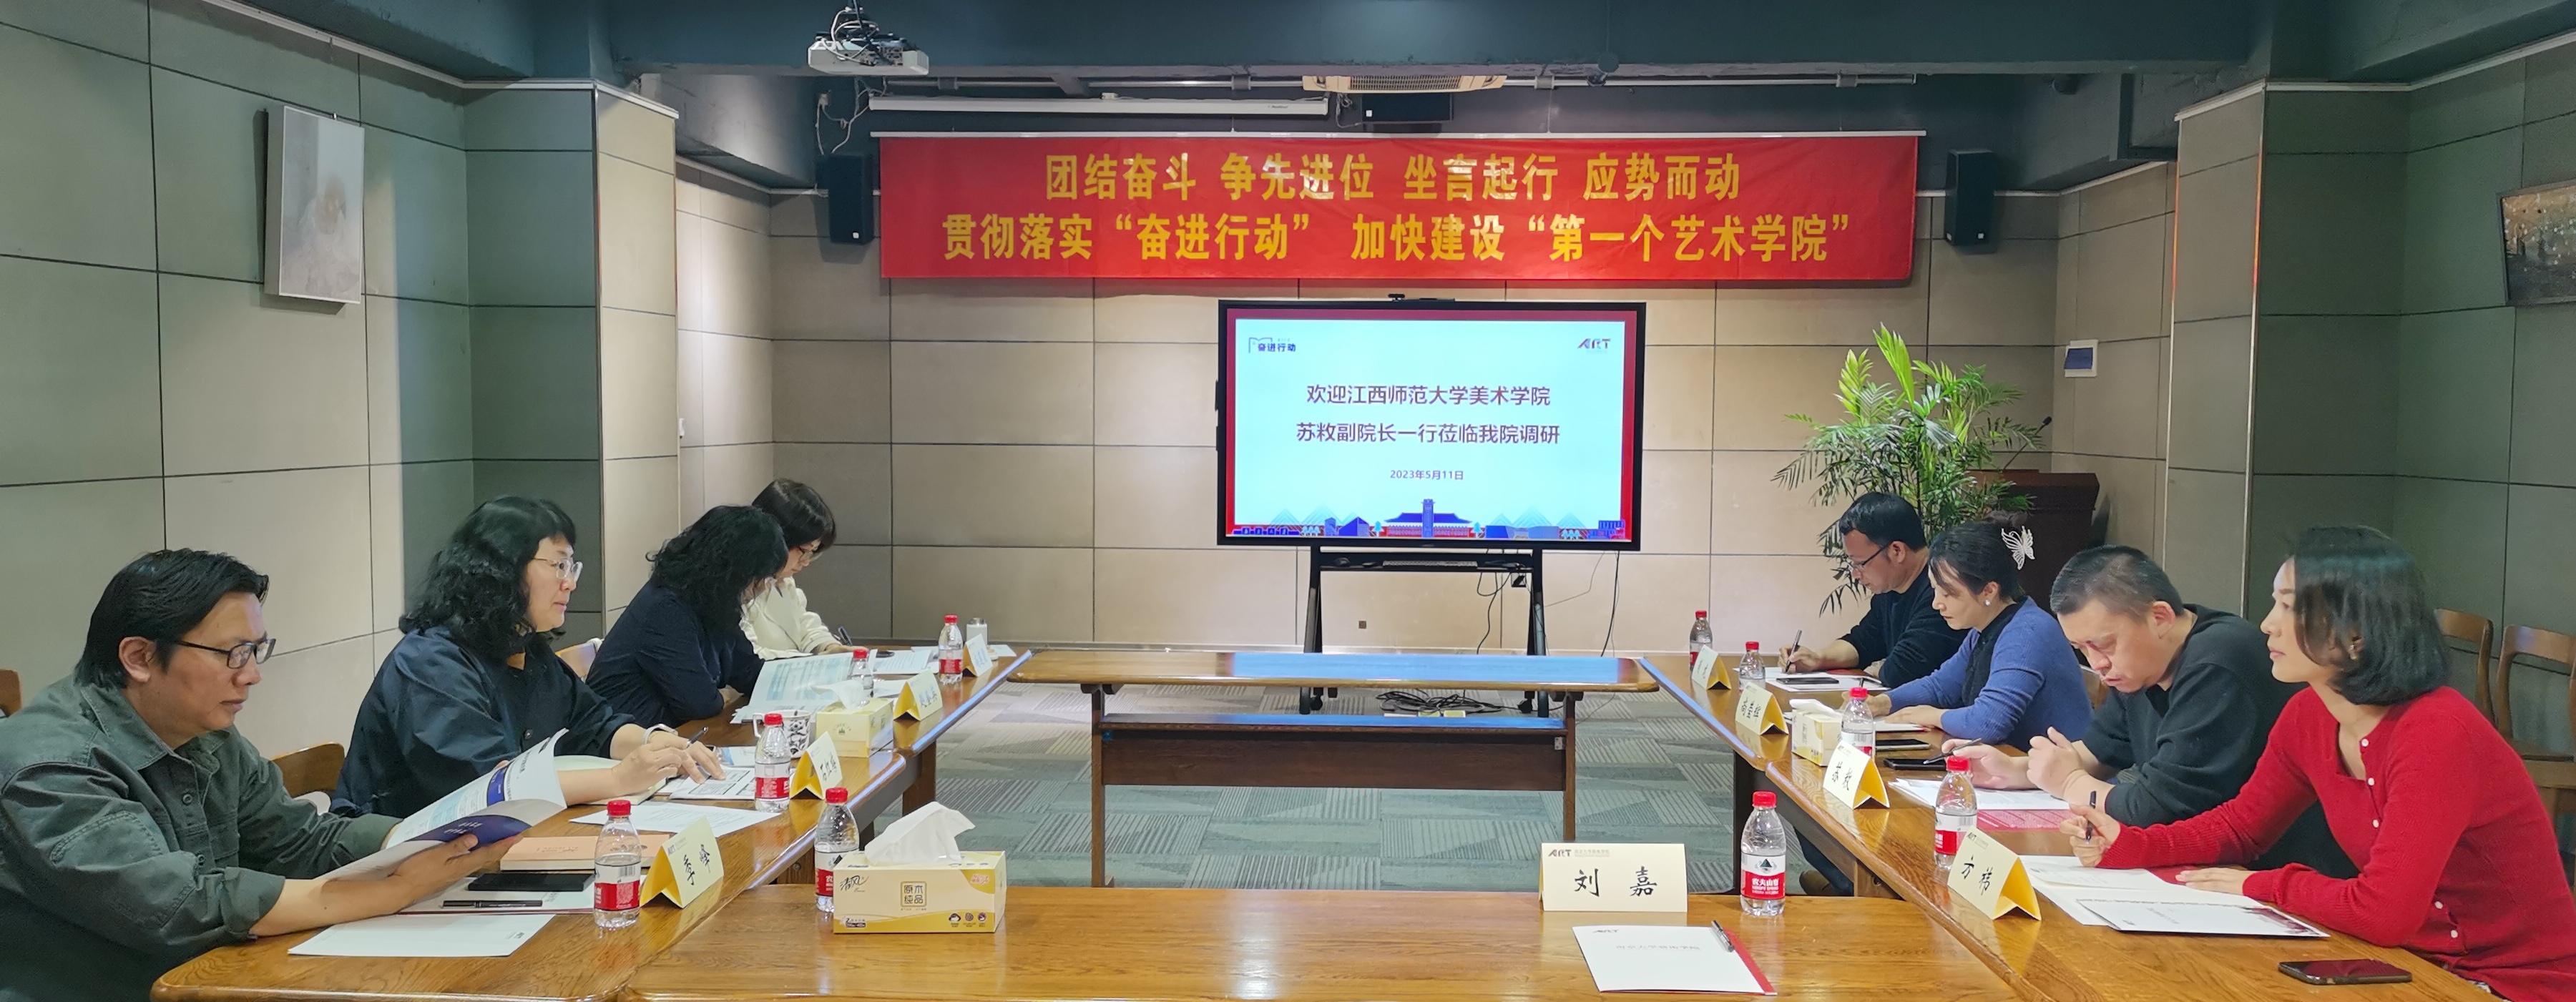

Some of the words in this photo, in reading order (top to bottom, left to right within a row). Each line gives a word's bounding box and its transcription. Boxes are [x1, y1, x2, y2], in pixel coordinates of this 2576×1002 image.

[1046, 152, 1196, 200] 团结奋斗
[1220, 152, 1374, 200] 争先进位
[1404, 152, 1558, 201] 坐言起行
[1582, 152, 1740, 200] 应势而动
[1258, 343, 1296, 352] 奋进行动
[1306, 385, 1551, 406] 欢迎江西师范大学美术学院
[1296, 422, 1560, 444] 苏敉副院长一行莅临我院调研
[1390, 469, 1464, 481] 2023年5月11日
[1548, 849, 1572, 858] ART
